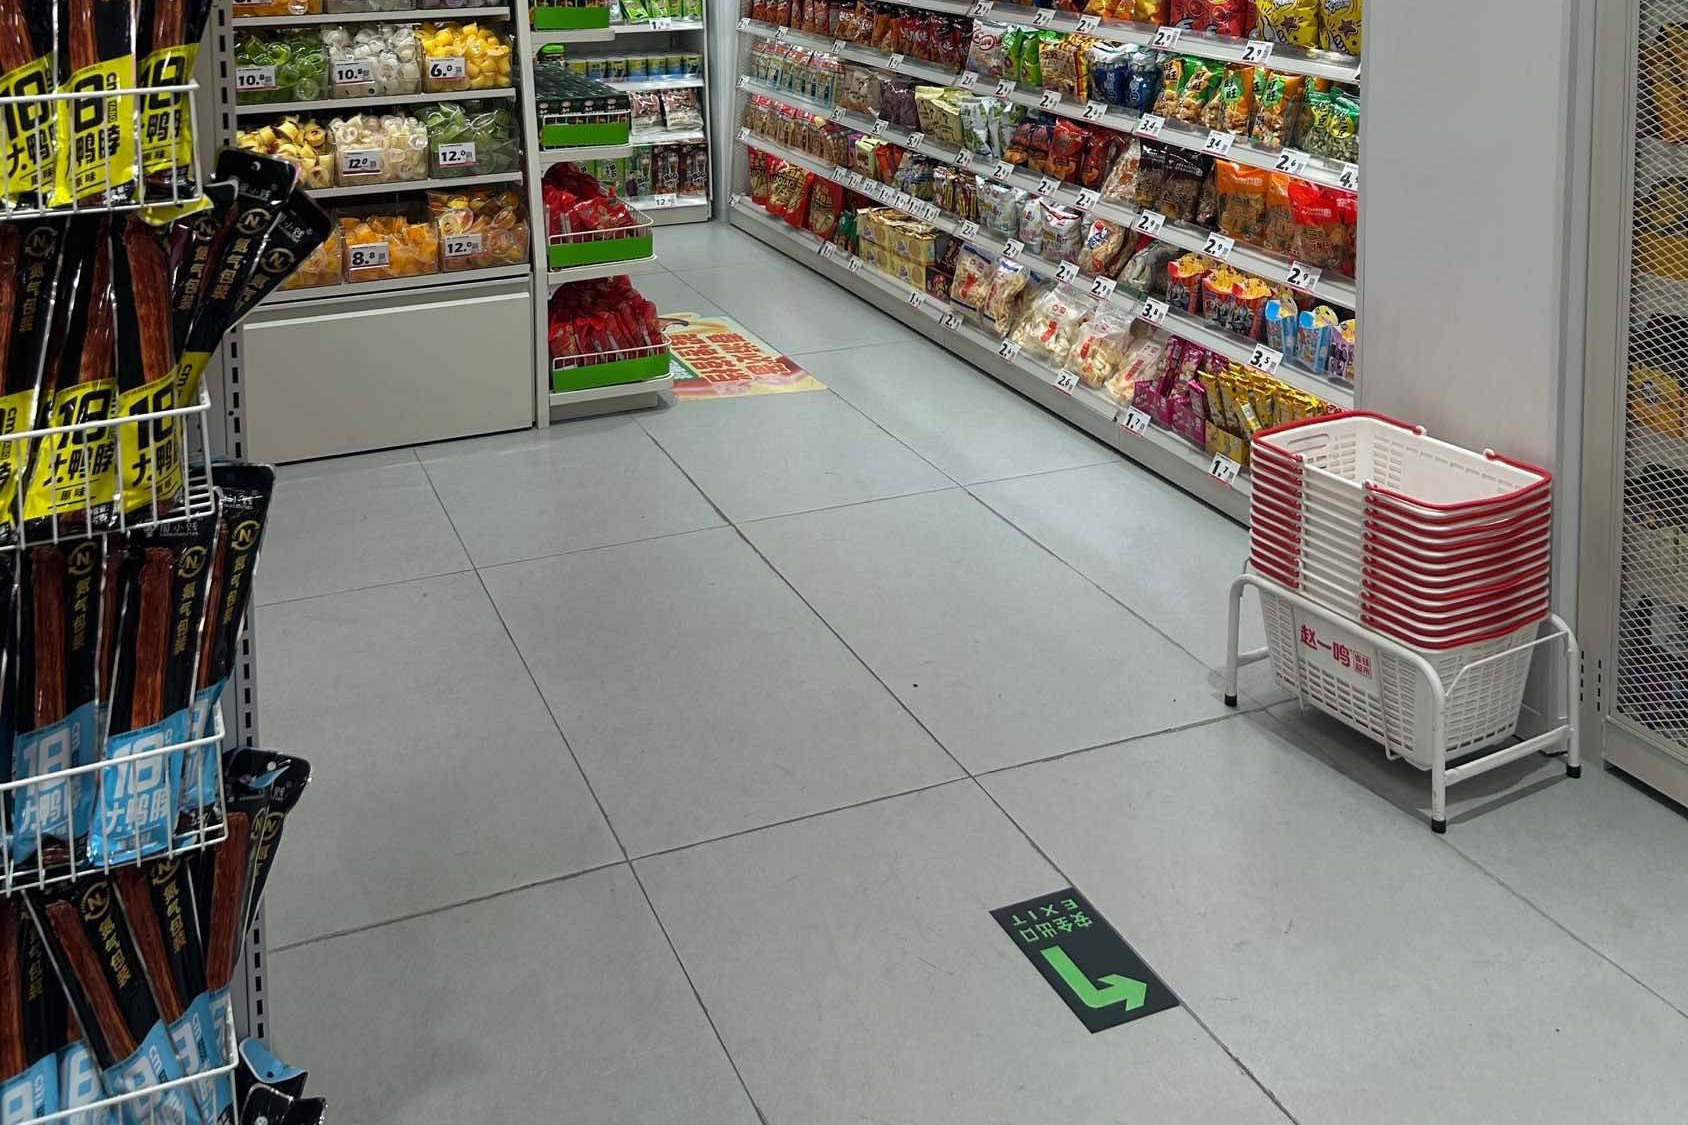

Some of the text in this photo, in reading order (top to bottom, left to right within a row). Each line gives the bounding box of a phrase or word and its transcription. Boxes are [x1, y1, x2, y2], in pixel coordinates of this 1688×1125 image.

[1155, 32, 1171, 46] 2.9
[1242, 46, 1262, 61] 2.9
[430, 64, 453, 78] 6.0
[1276, 155, 1297, 171] 2.6
[1204, 239, 1223, 255] 2.9
[352, 251, 376, 265] 8.8
[1287, 268, 1309, 285] 2.9
[1091, 280, 1107, 296] 2.9
[1142, 303, 1159, 319] 3.8
[1250, 350, 1271, 368] 3.5
[57, 388, 113, 450] 18
[1126, 413, 1141, 429] 1.7
[132, 440, 178, 487] 大鸭
[1212, 460, 1229, 477] 1.7
[1301, 624, 1350, 667] 赵一鸣
[1011, 898, 1079, 926] EXIT
[1020, 911, 1093, 943] 安全出口
